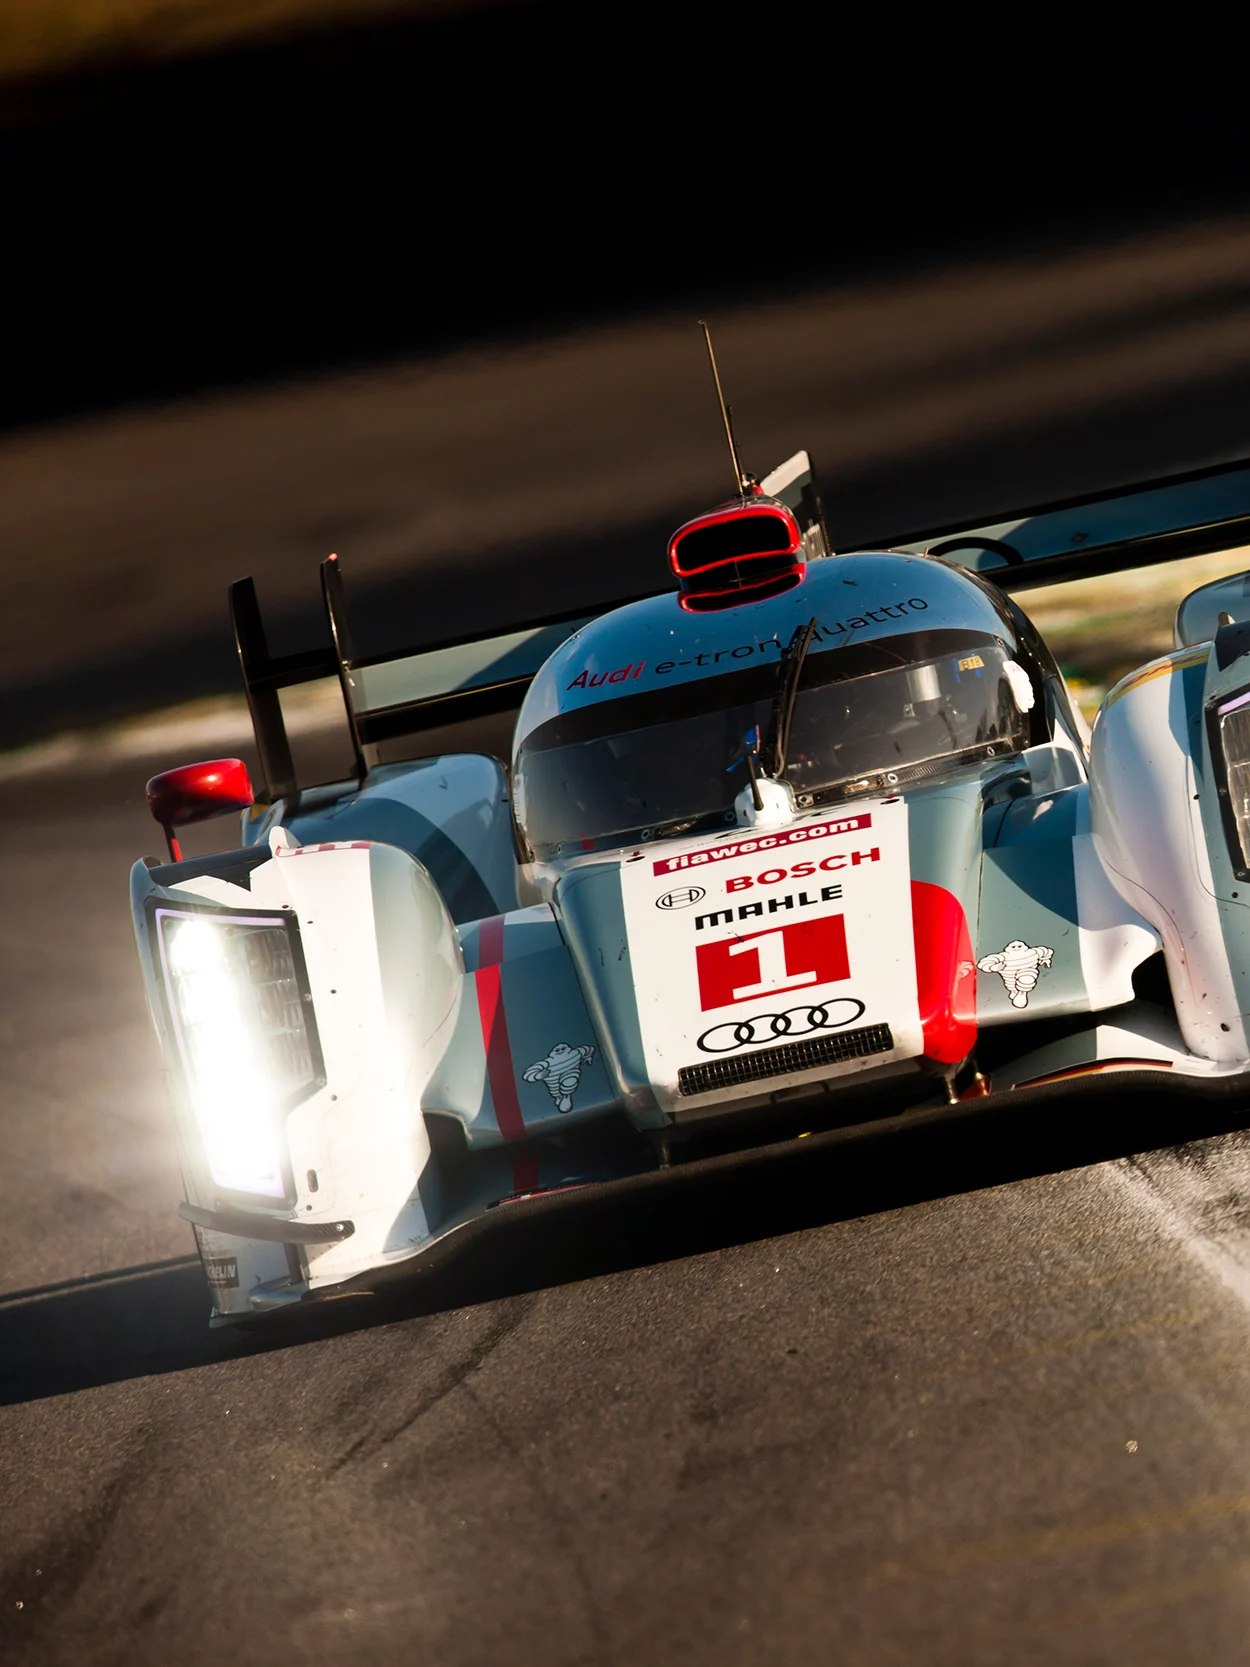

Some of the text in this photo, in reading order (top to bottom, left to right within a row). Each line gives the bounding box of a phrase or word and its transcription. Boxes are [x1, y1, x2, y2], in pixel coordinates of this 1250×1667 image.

[565, 660, 646, 691] Audi
[654, 637, 783, 675] e-tron
[665, 818, 859, 871] fiawec.com
[725, 846, 881, 894] BOSCH
[694, 883, 844, 931] MAHLE
[728, 930, 818, 1000] 1
